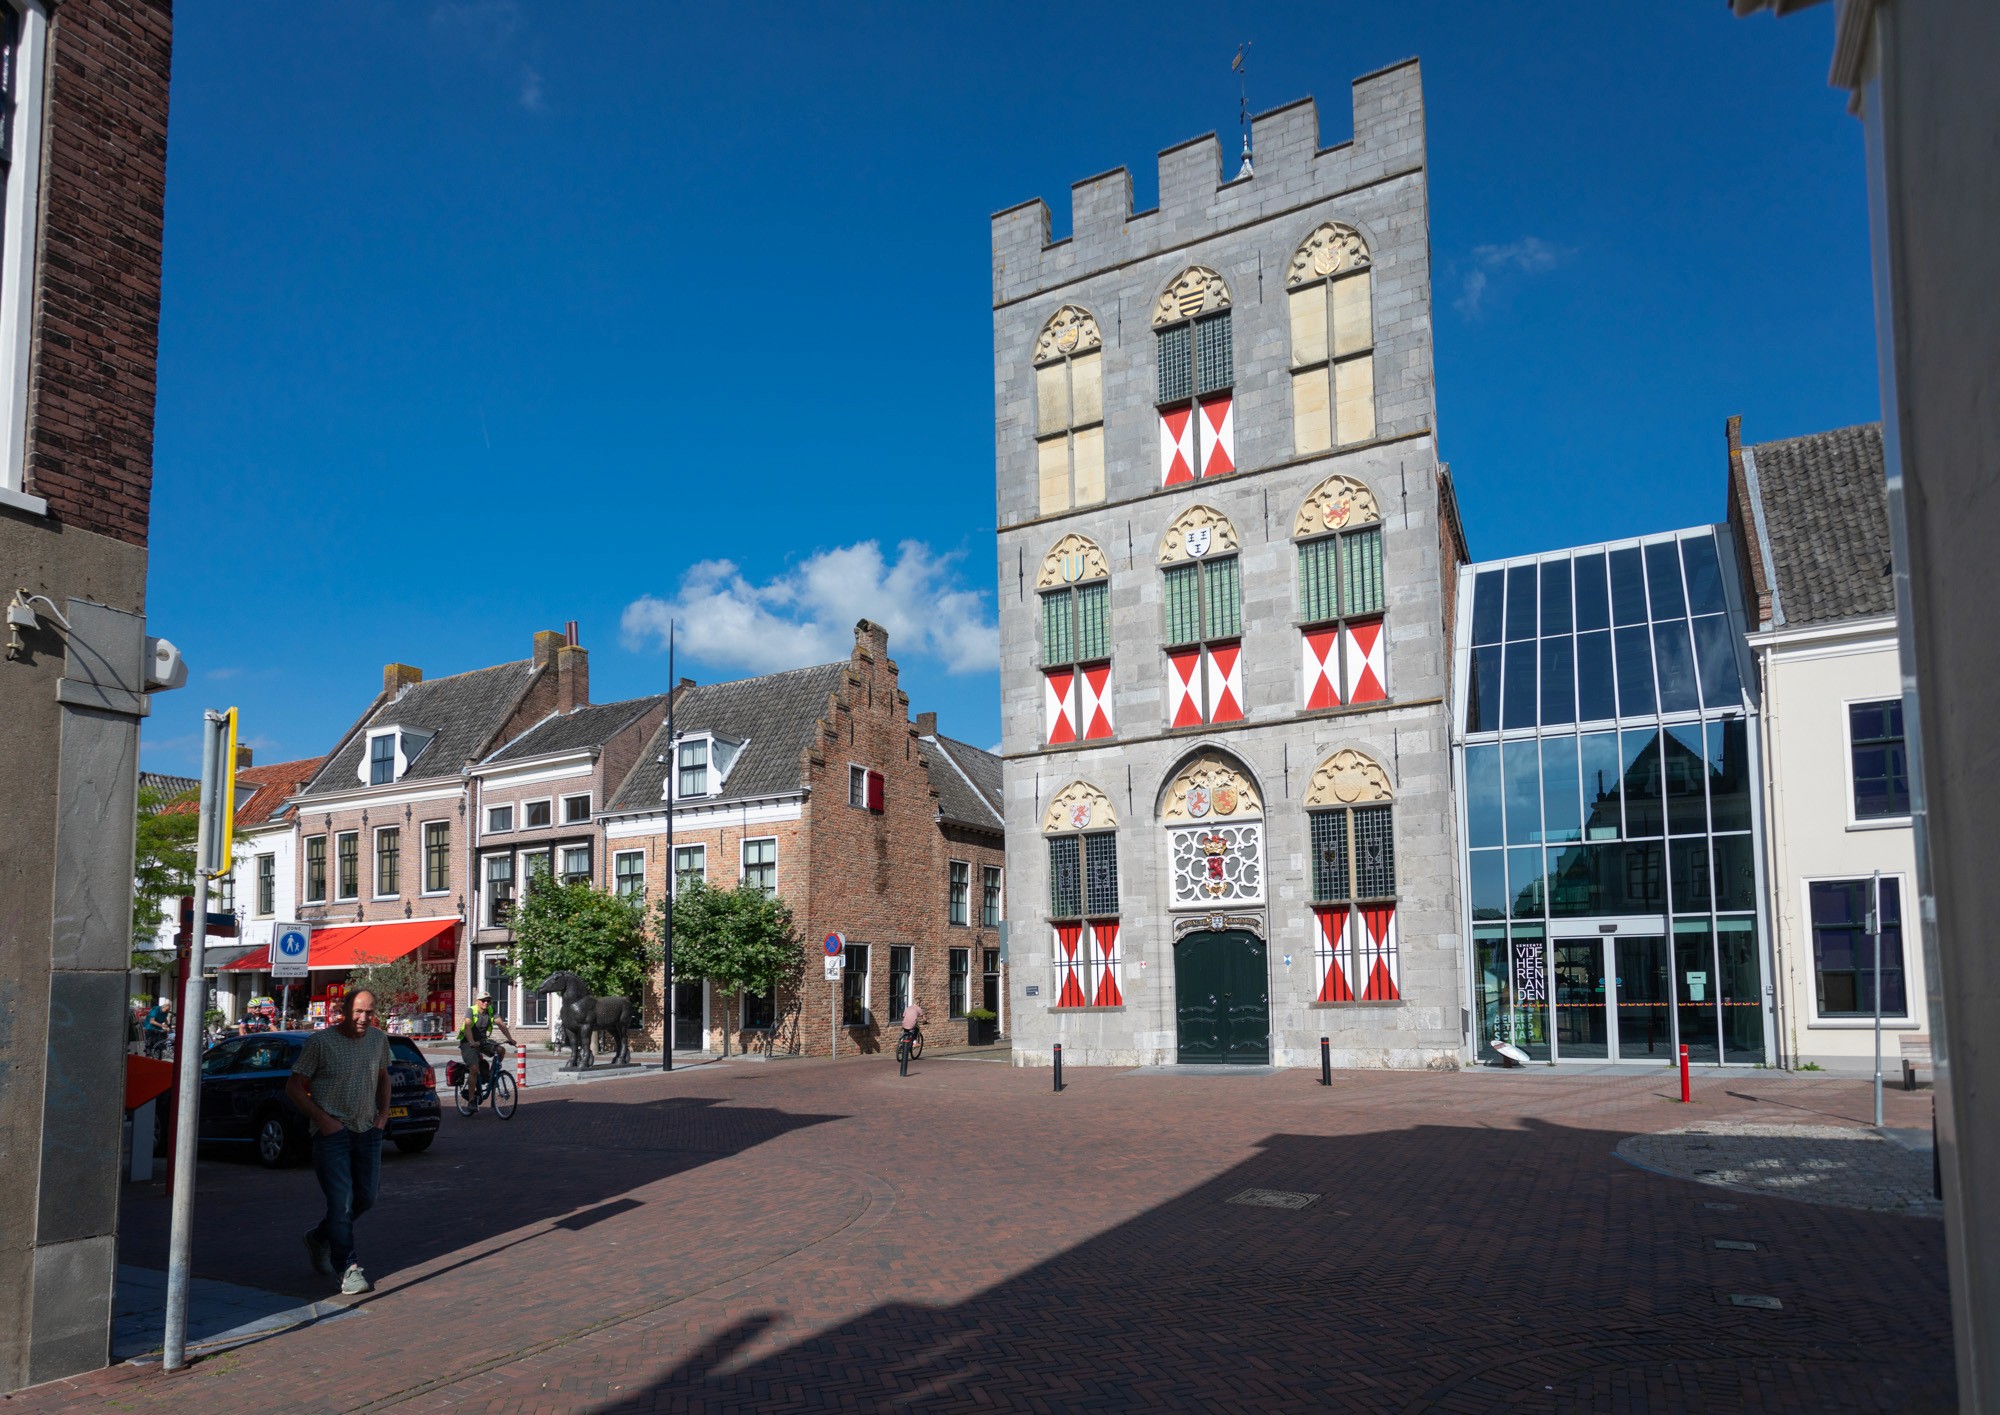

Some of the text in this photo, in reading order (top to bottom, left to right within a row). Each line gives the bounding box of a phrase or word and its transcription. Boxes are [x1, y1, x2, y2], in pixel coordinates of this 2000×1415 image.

[1516, 947, 1543, 958] VIJF
[1516, 958, 1543, 969] HEE
[1517, 968, 1544, 979] REN
[1517, 979, 1544, 990] LAN
[1518, 989, 1545, 1000] DEN
